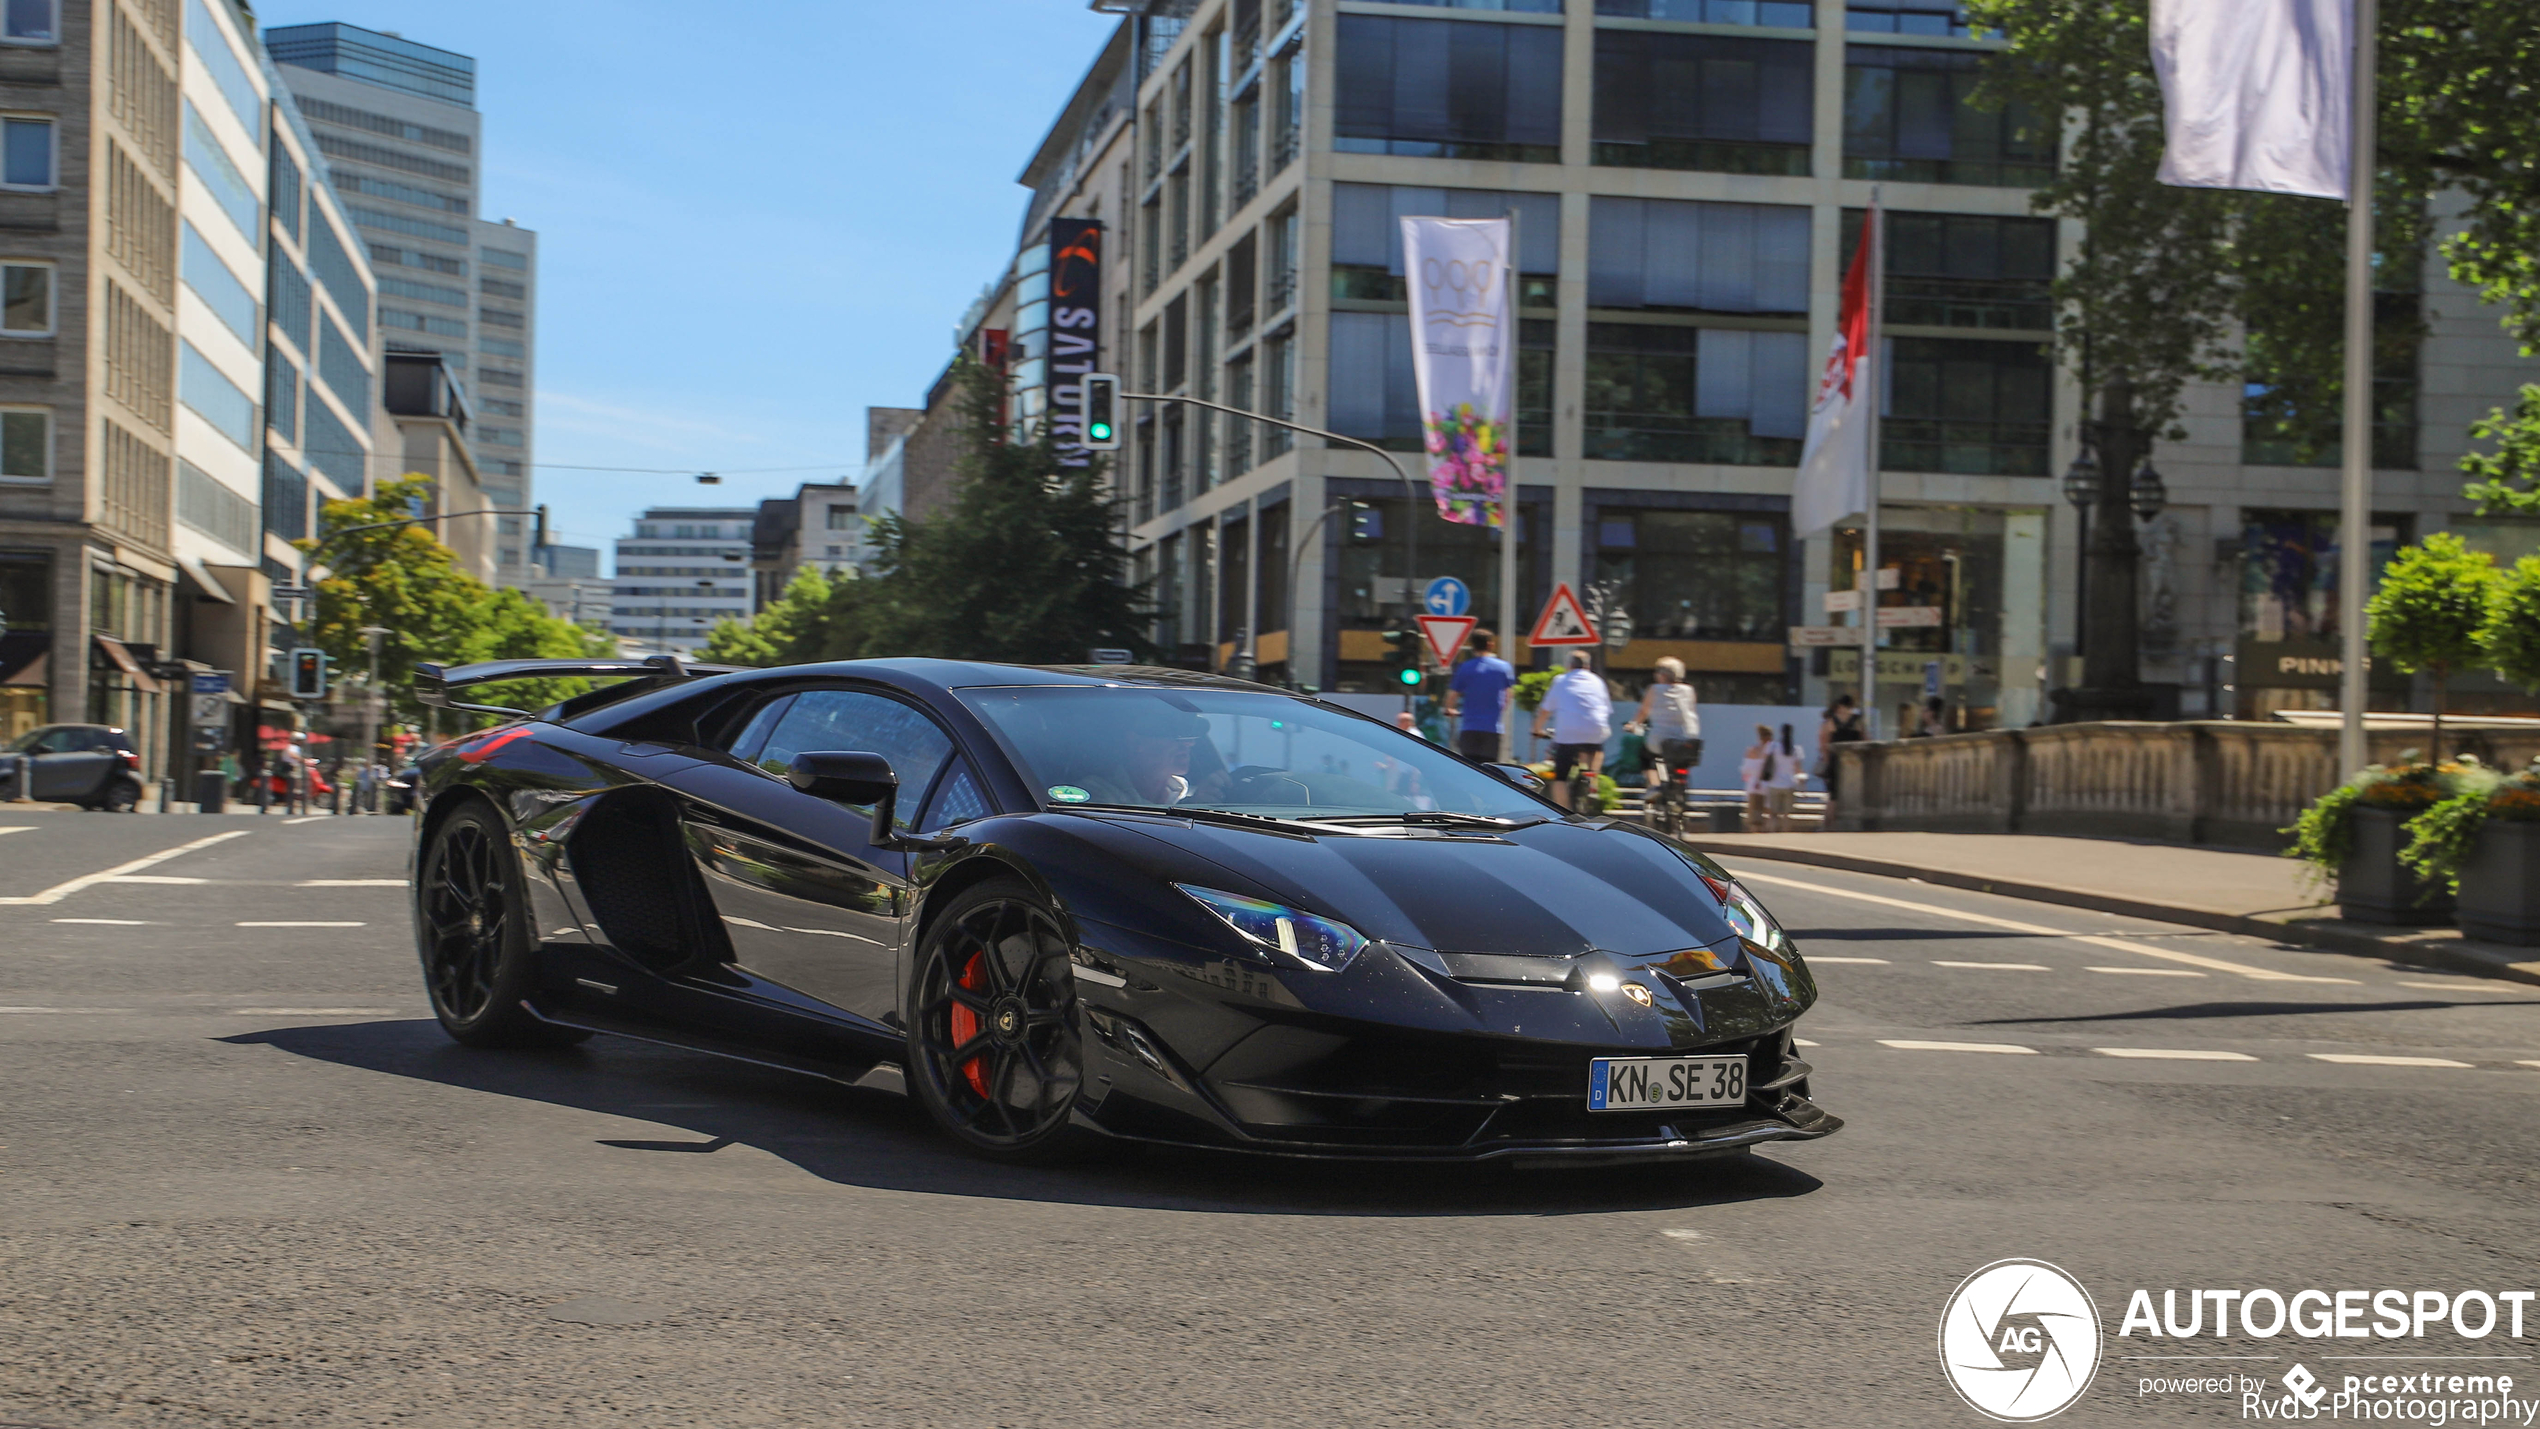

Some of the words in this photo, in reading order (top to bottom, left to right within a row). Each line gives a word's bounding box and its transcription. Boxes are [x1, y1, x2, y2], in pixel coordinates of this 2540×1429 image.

[1608, 1065, 1648, 1102] KN
[1667, 1063, 1704, 1101] SE
[1710, 1062, 1743, 1099] 38
